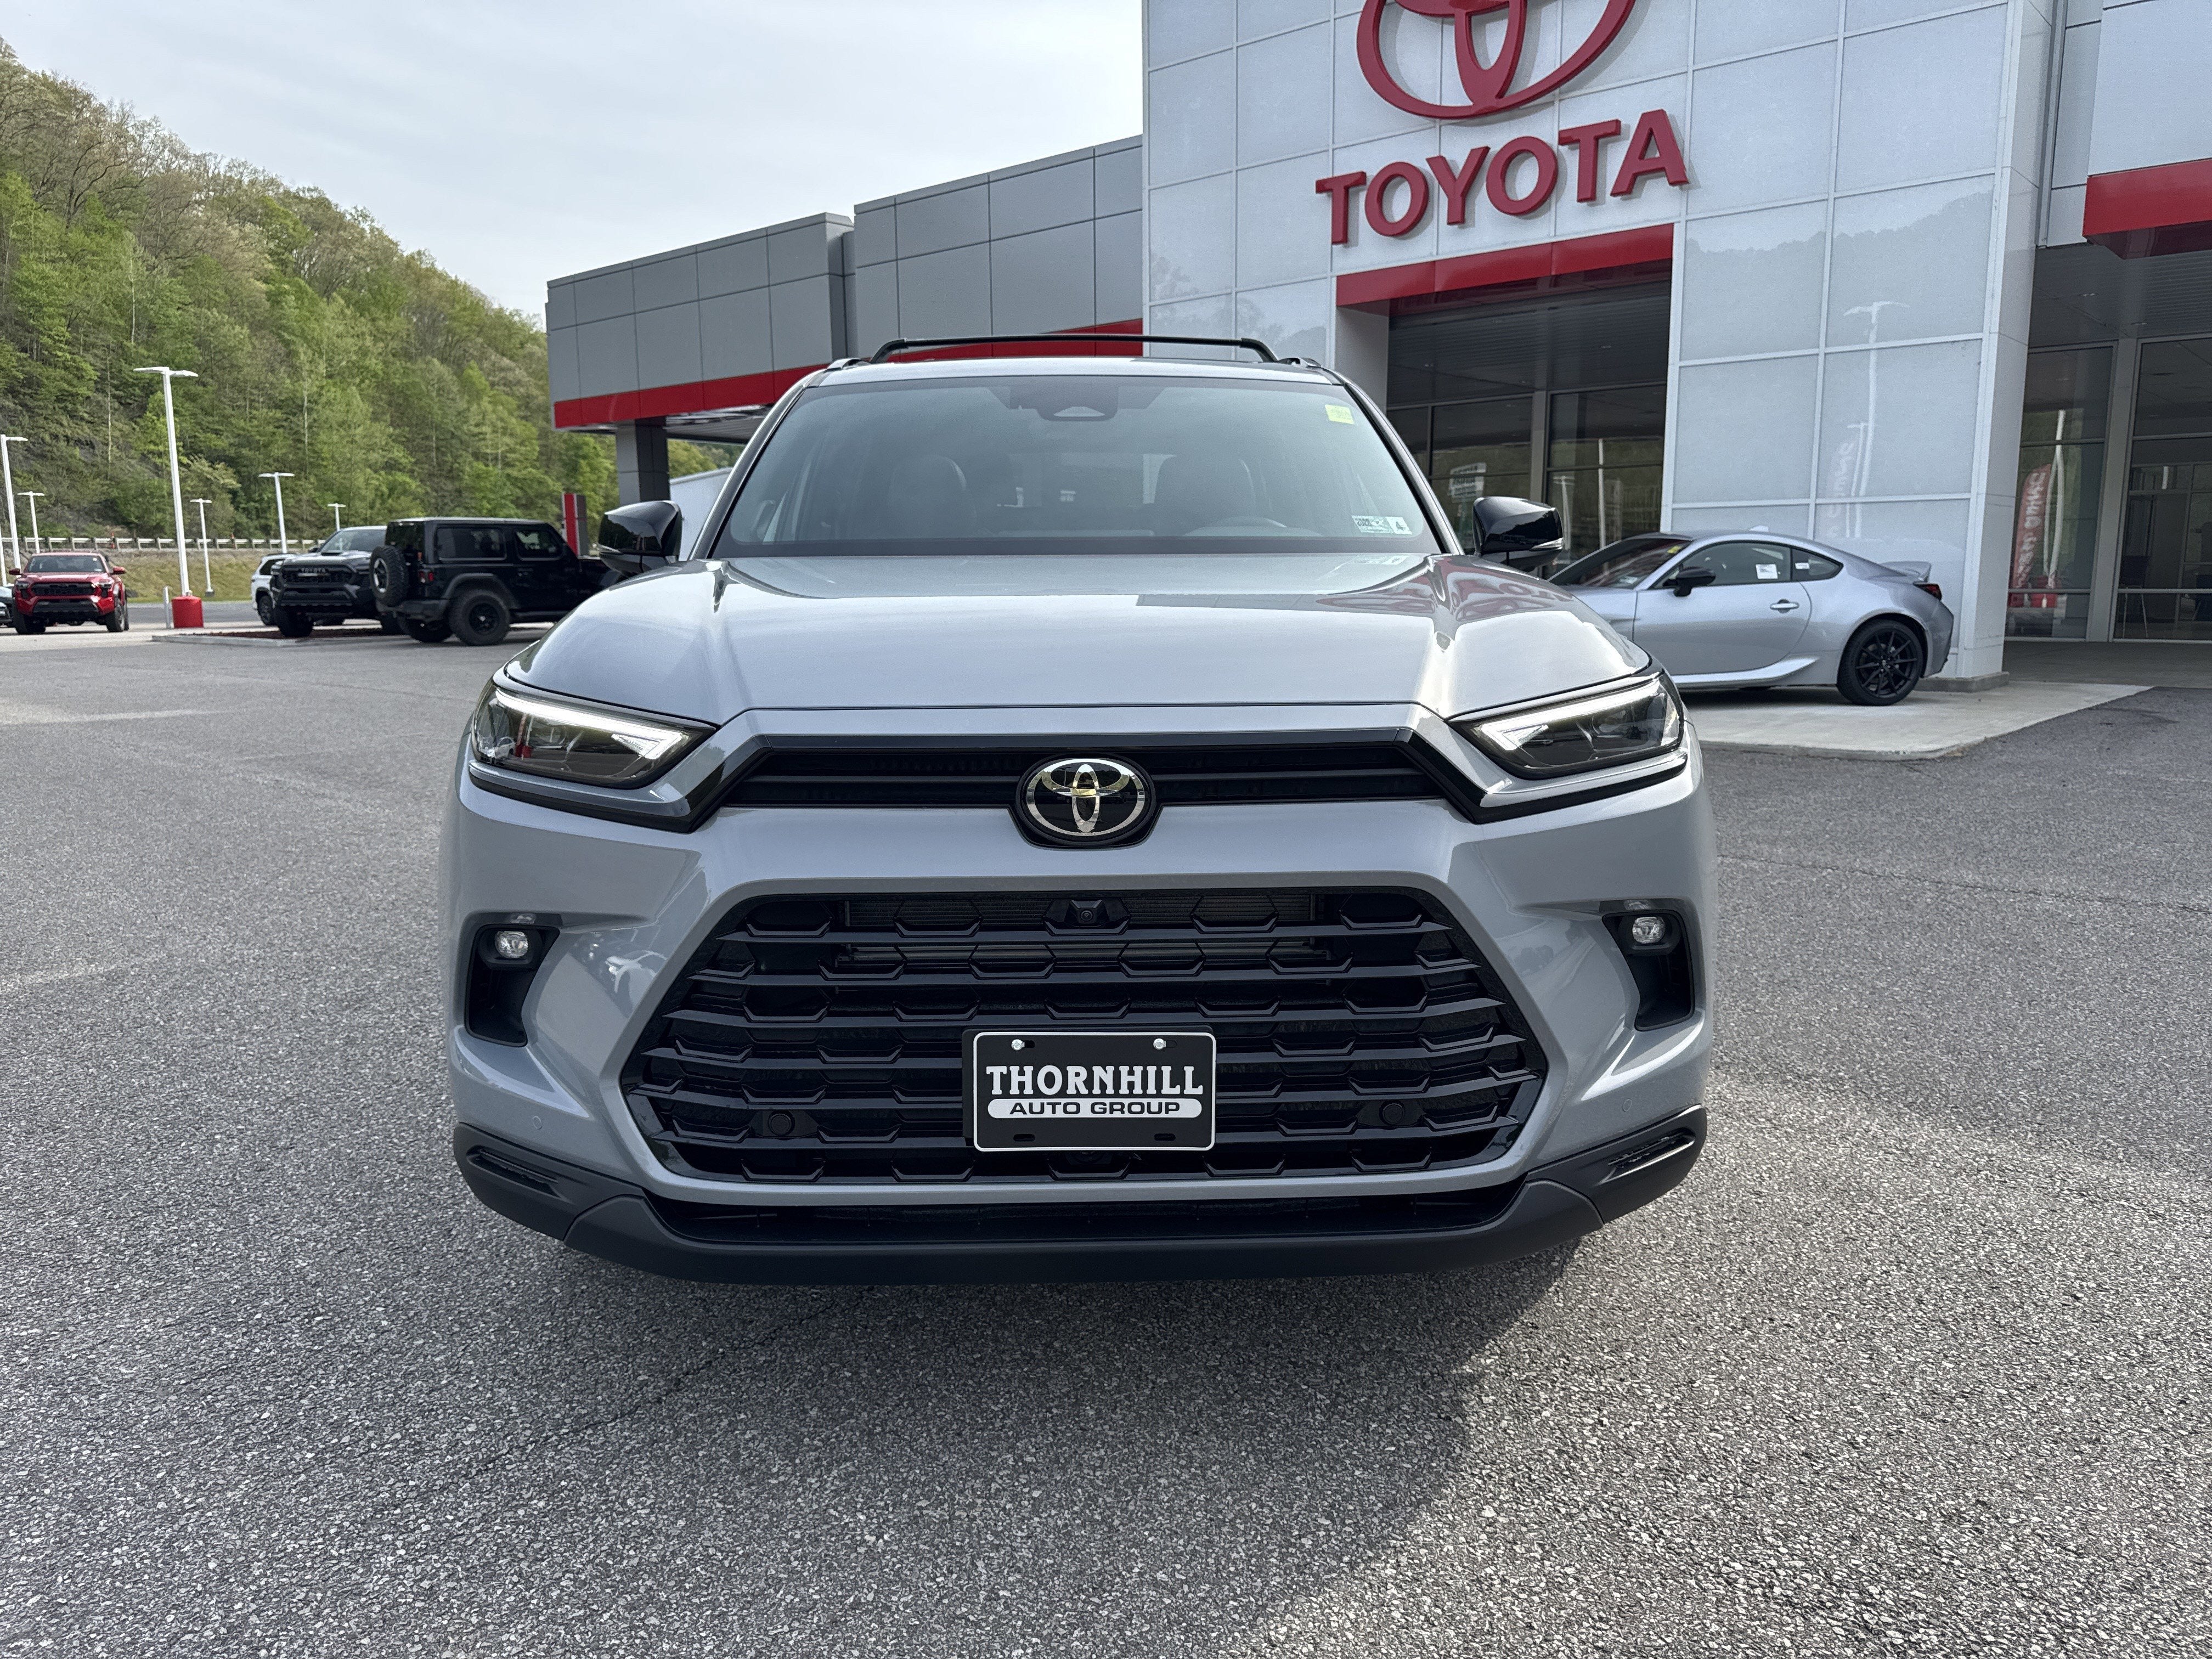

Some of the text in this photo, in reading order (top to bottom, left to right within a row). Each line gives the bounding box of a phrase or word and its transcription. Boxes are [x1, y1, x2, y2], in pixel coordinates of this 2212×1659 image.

[1316, 108, 1690, 245] TOYOTA
[986, 1065, 1204, 1096] THORNHILL
[1009, 1102, 1181, 1115] AUTO GROUP
